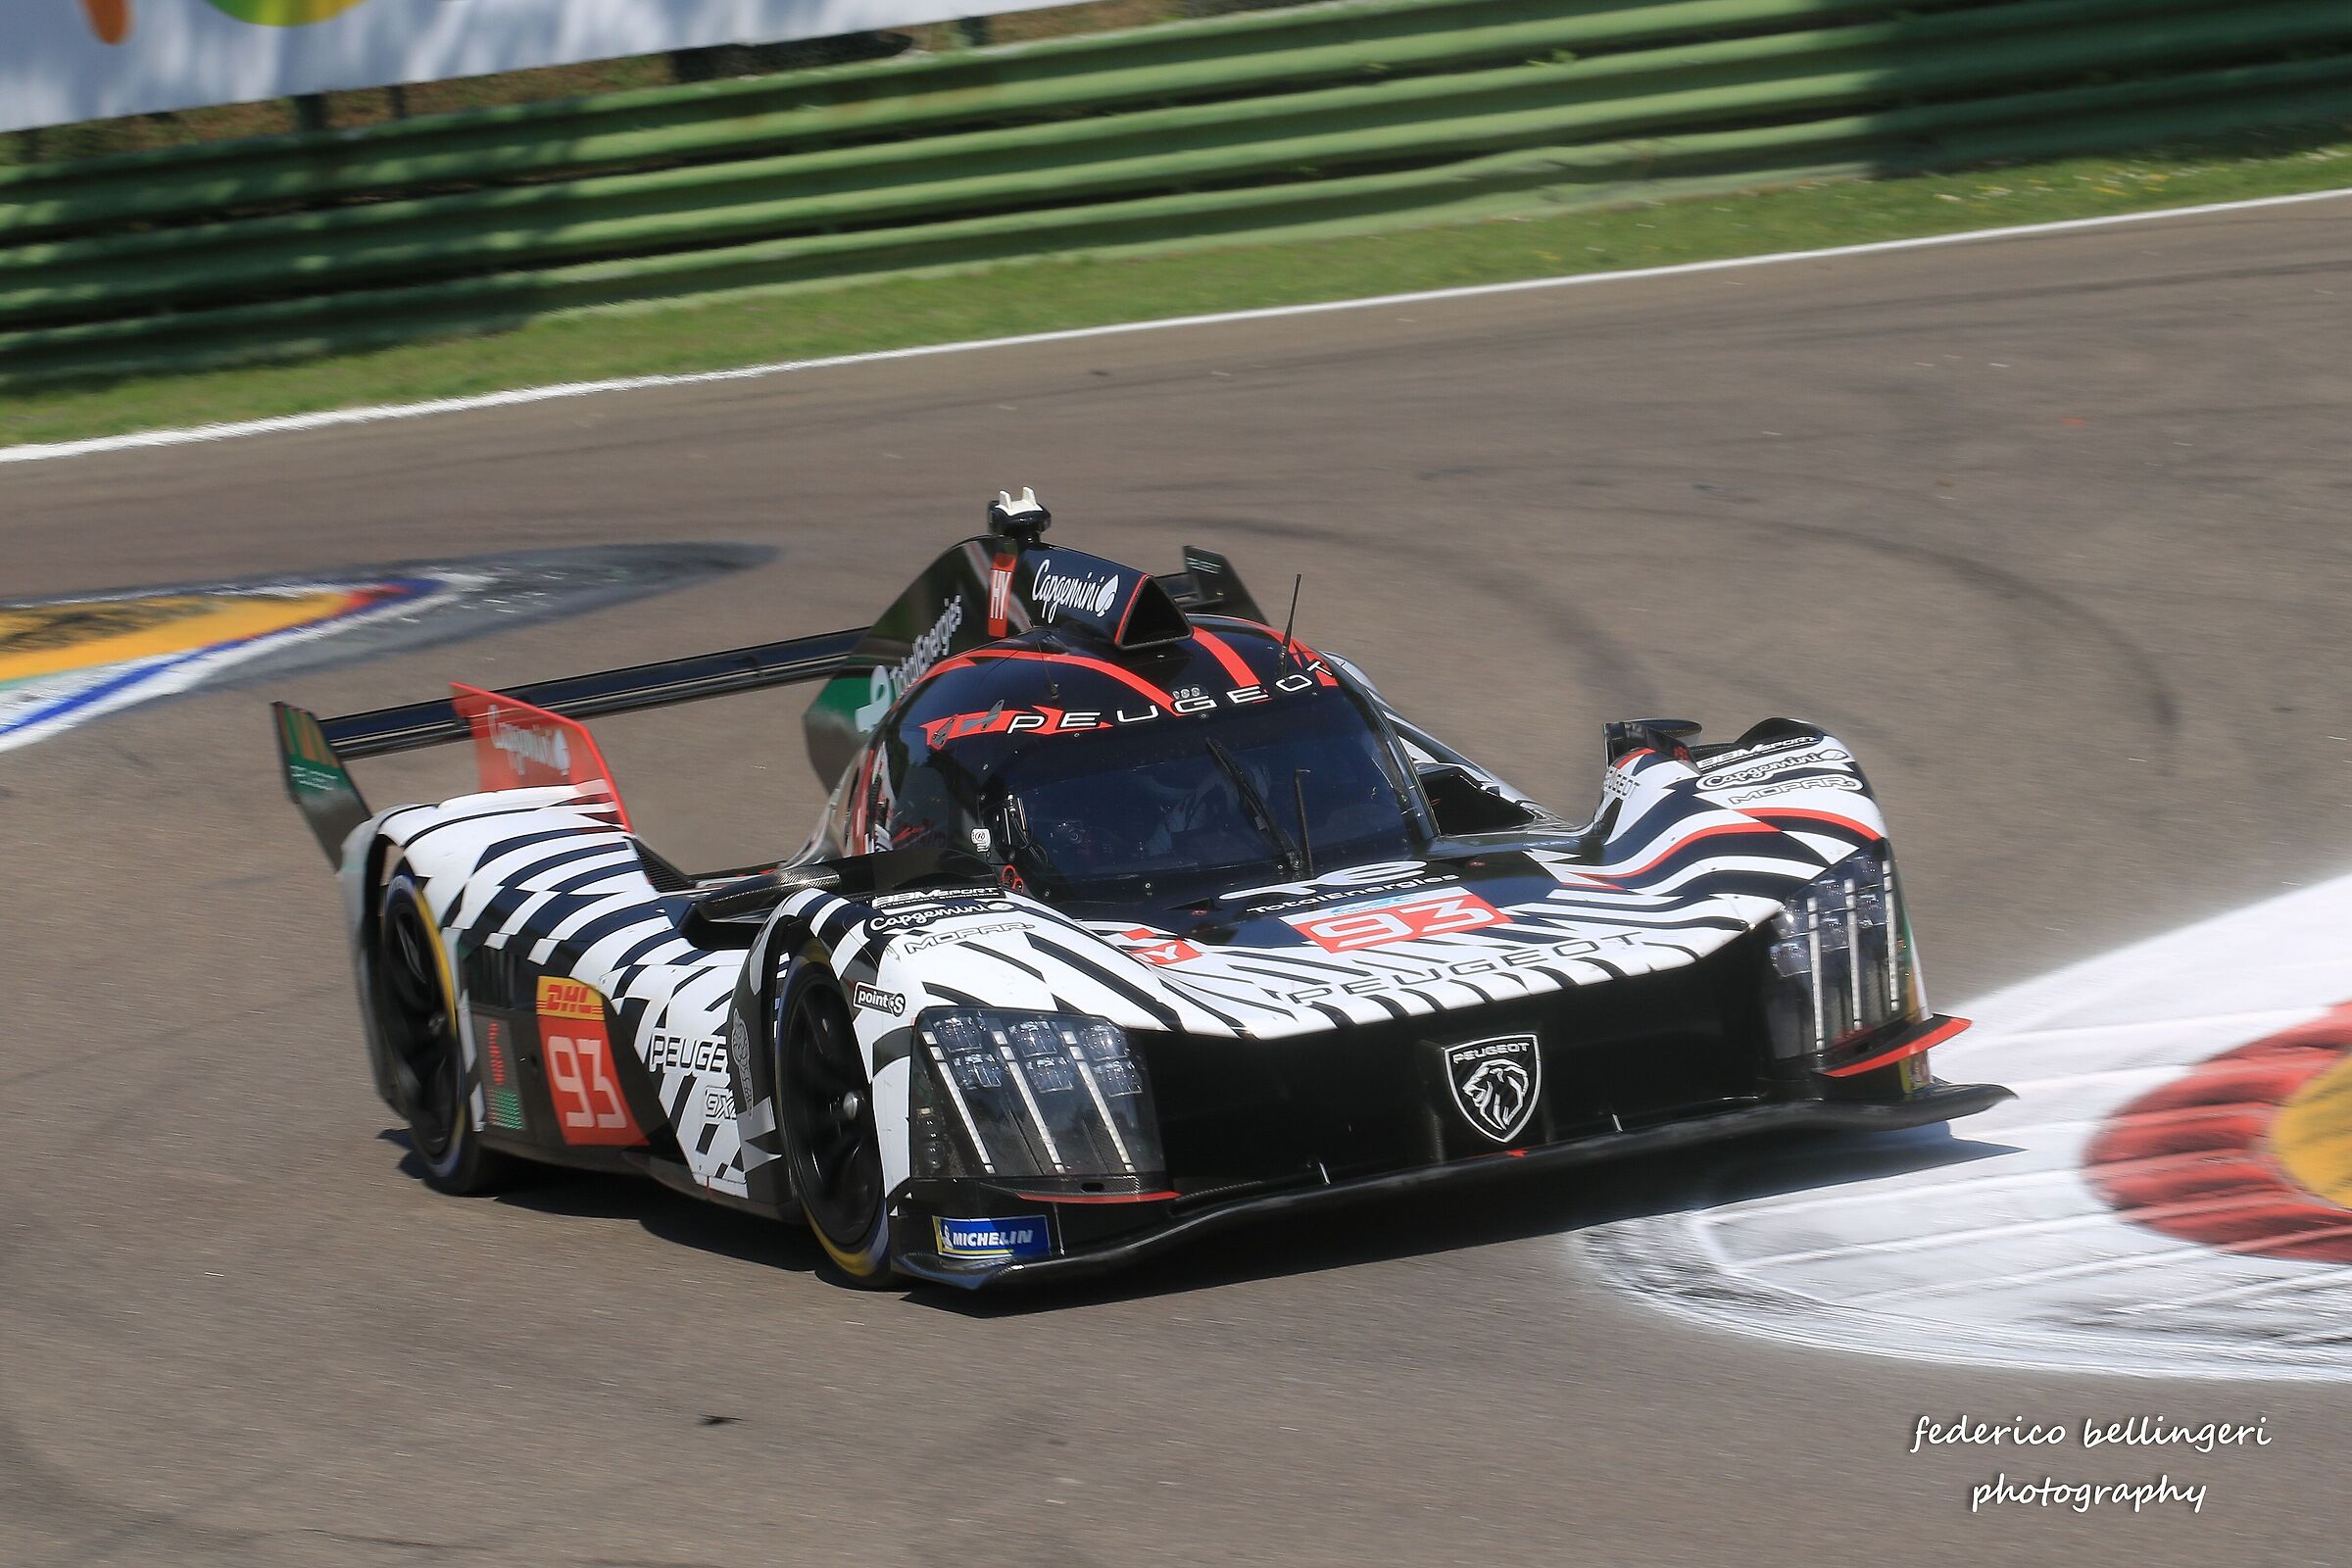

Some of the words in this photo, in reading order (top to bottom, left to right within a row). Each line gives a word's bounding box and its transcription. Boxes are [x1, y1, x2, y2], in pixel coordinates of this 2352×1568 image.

[1032, 559, 1104, 624] Capgemini
[1007, 661, 1333, 734] PEUGEOT
[1705, 753, 1820, 786] Capgemini
[1729, 776, 1850, 805] MOPAR
[1247, 874, 1460, 915] TotalEnergies
[869, 903, 990, 931] Capgemini
[1310, 897, 1495, 948] 93
[904, 922, 1027, 955] MOPAR
[1285, 931, 1643, 1004] PEUGEOT
[546, 984, 593, 1014] DHL
[1452, 1042, 1530, 1064] PEUGEOT
[548, 1035, 627, 1129] 93
[953, 1229, 1034, 1247] MICHELIN
